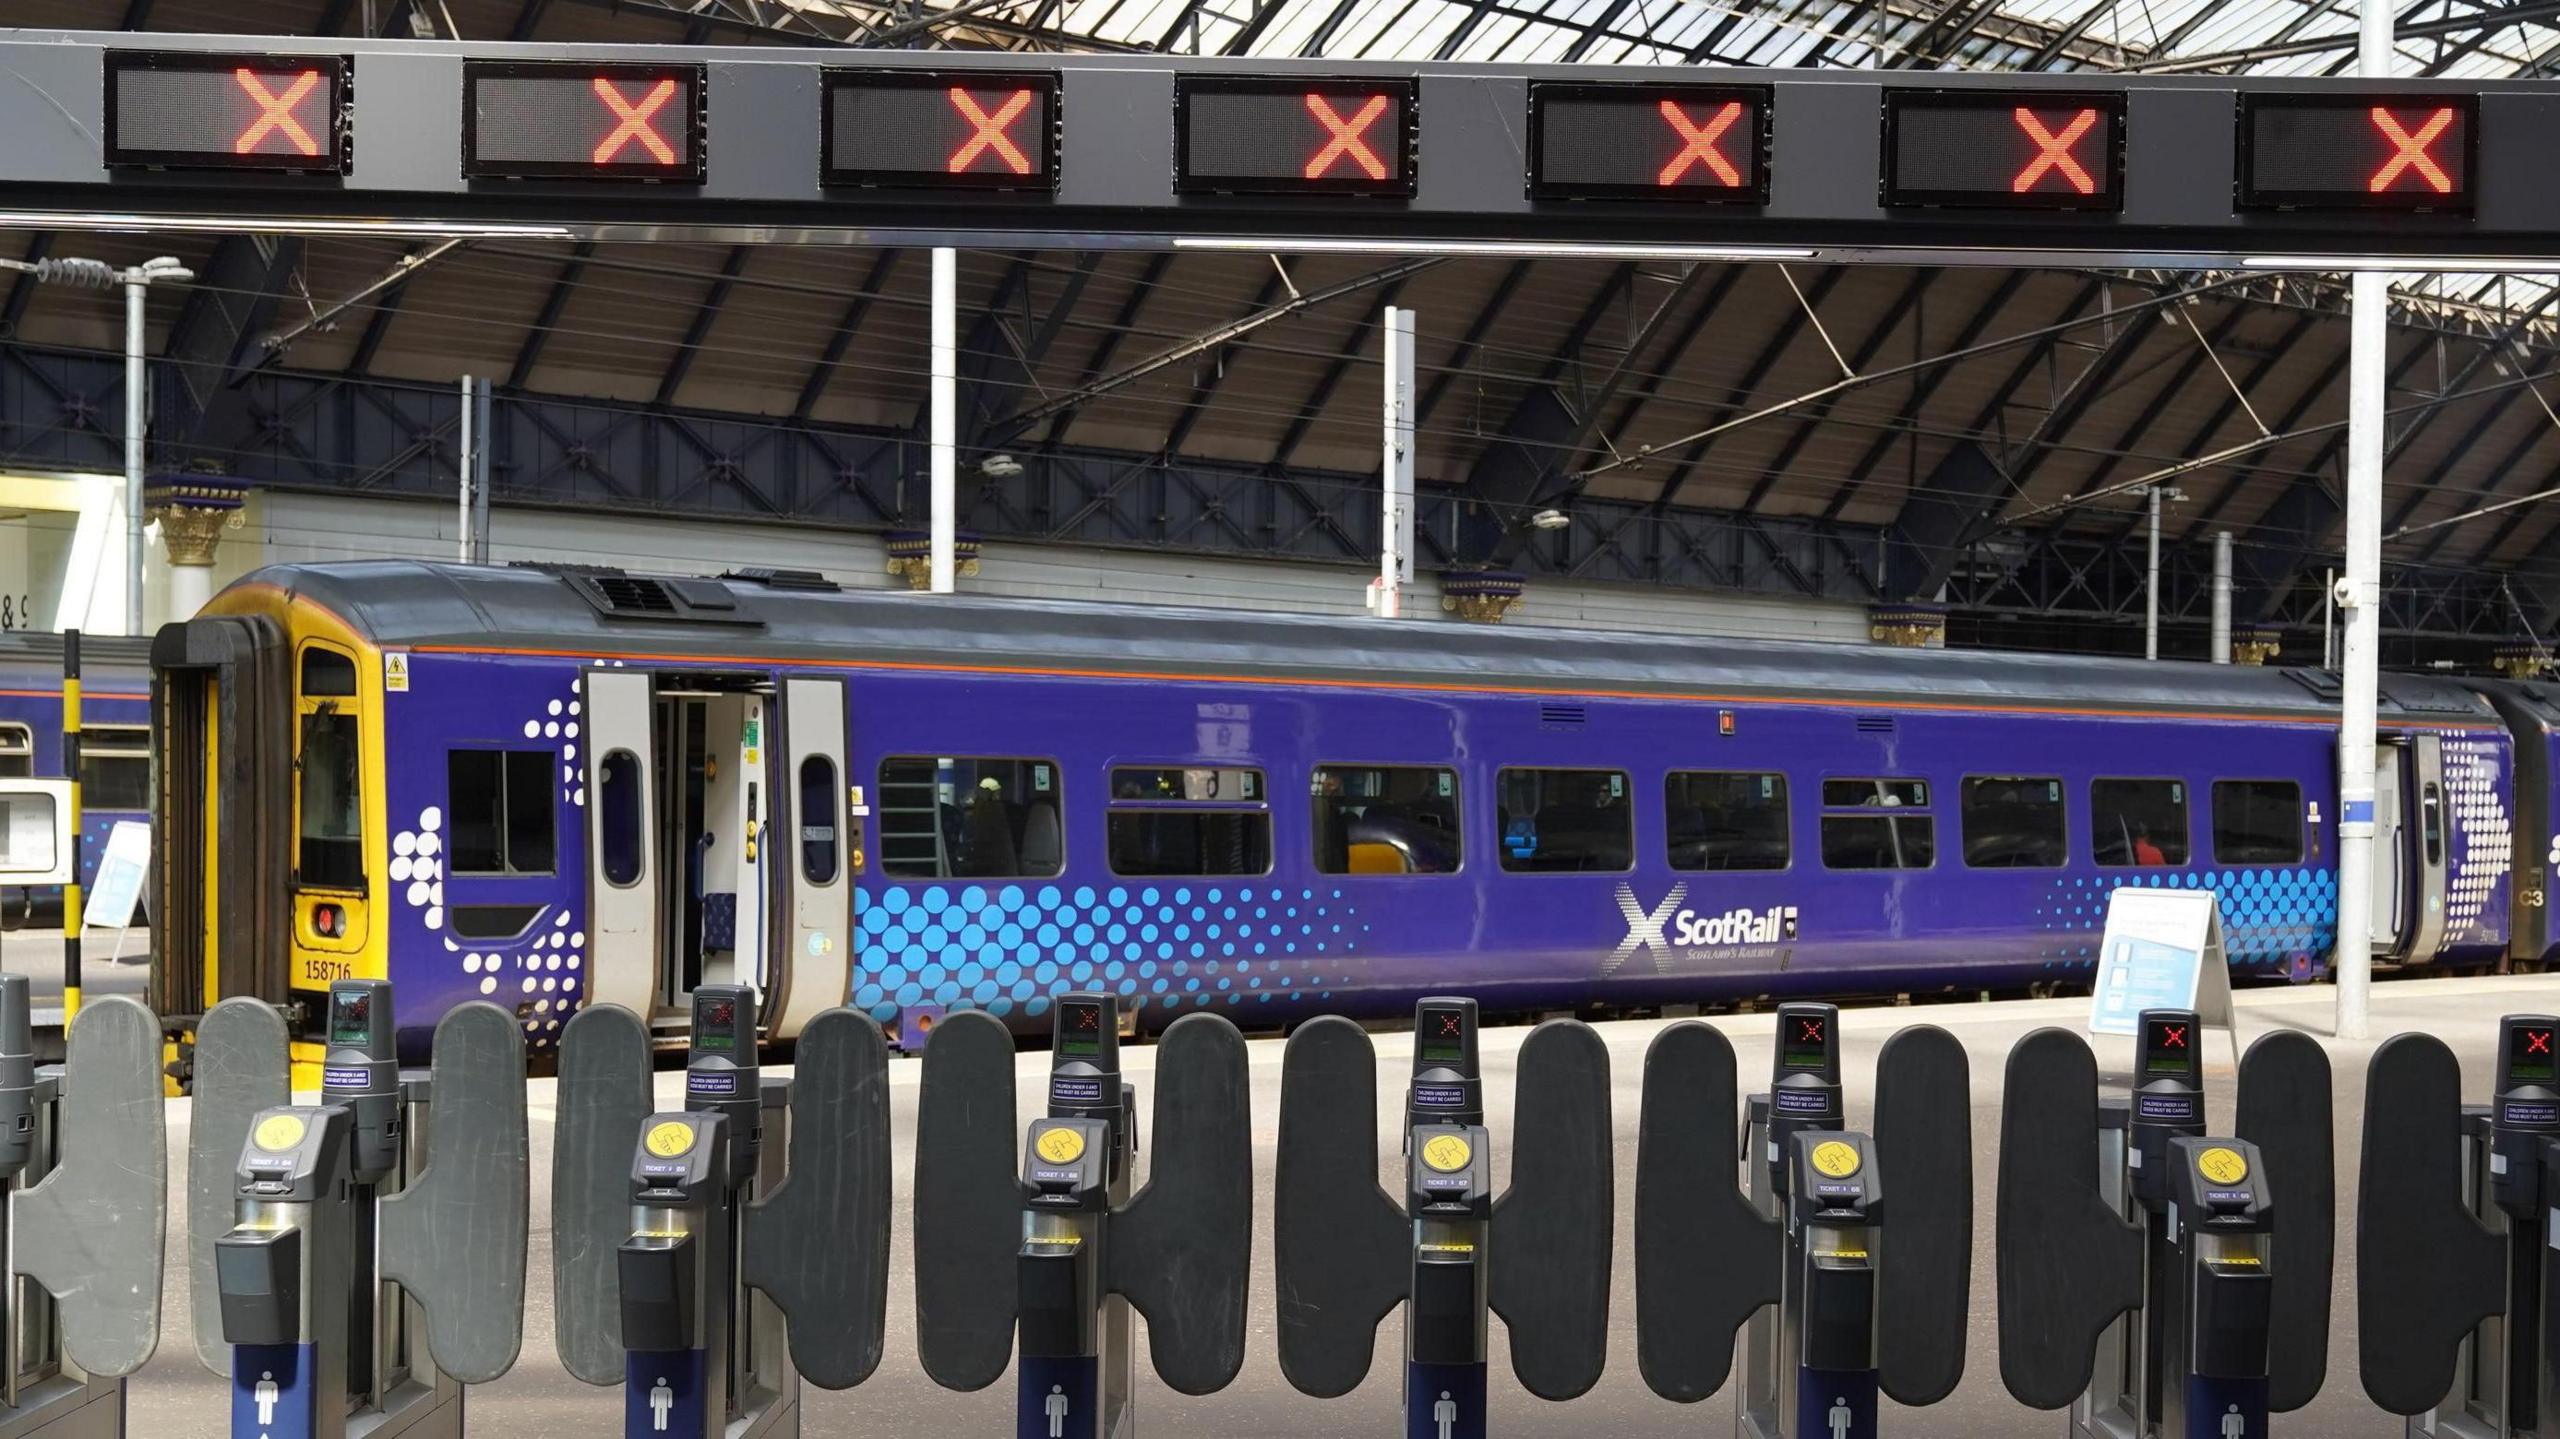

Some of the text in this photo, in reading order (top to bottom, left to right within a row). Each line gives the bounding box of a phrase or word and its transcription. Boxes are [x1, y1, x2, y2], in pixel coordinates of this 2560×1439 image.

[2520, 890, 2543, 907] C3
[1674, 906, 1782, 945] ScotRail
[306, 960, 351, 980] 158716
